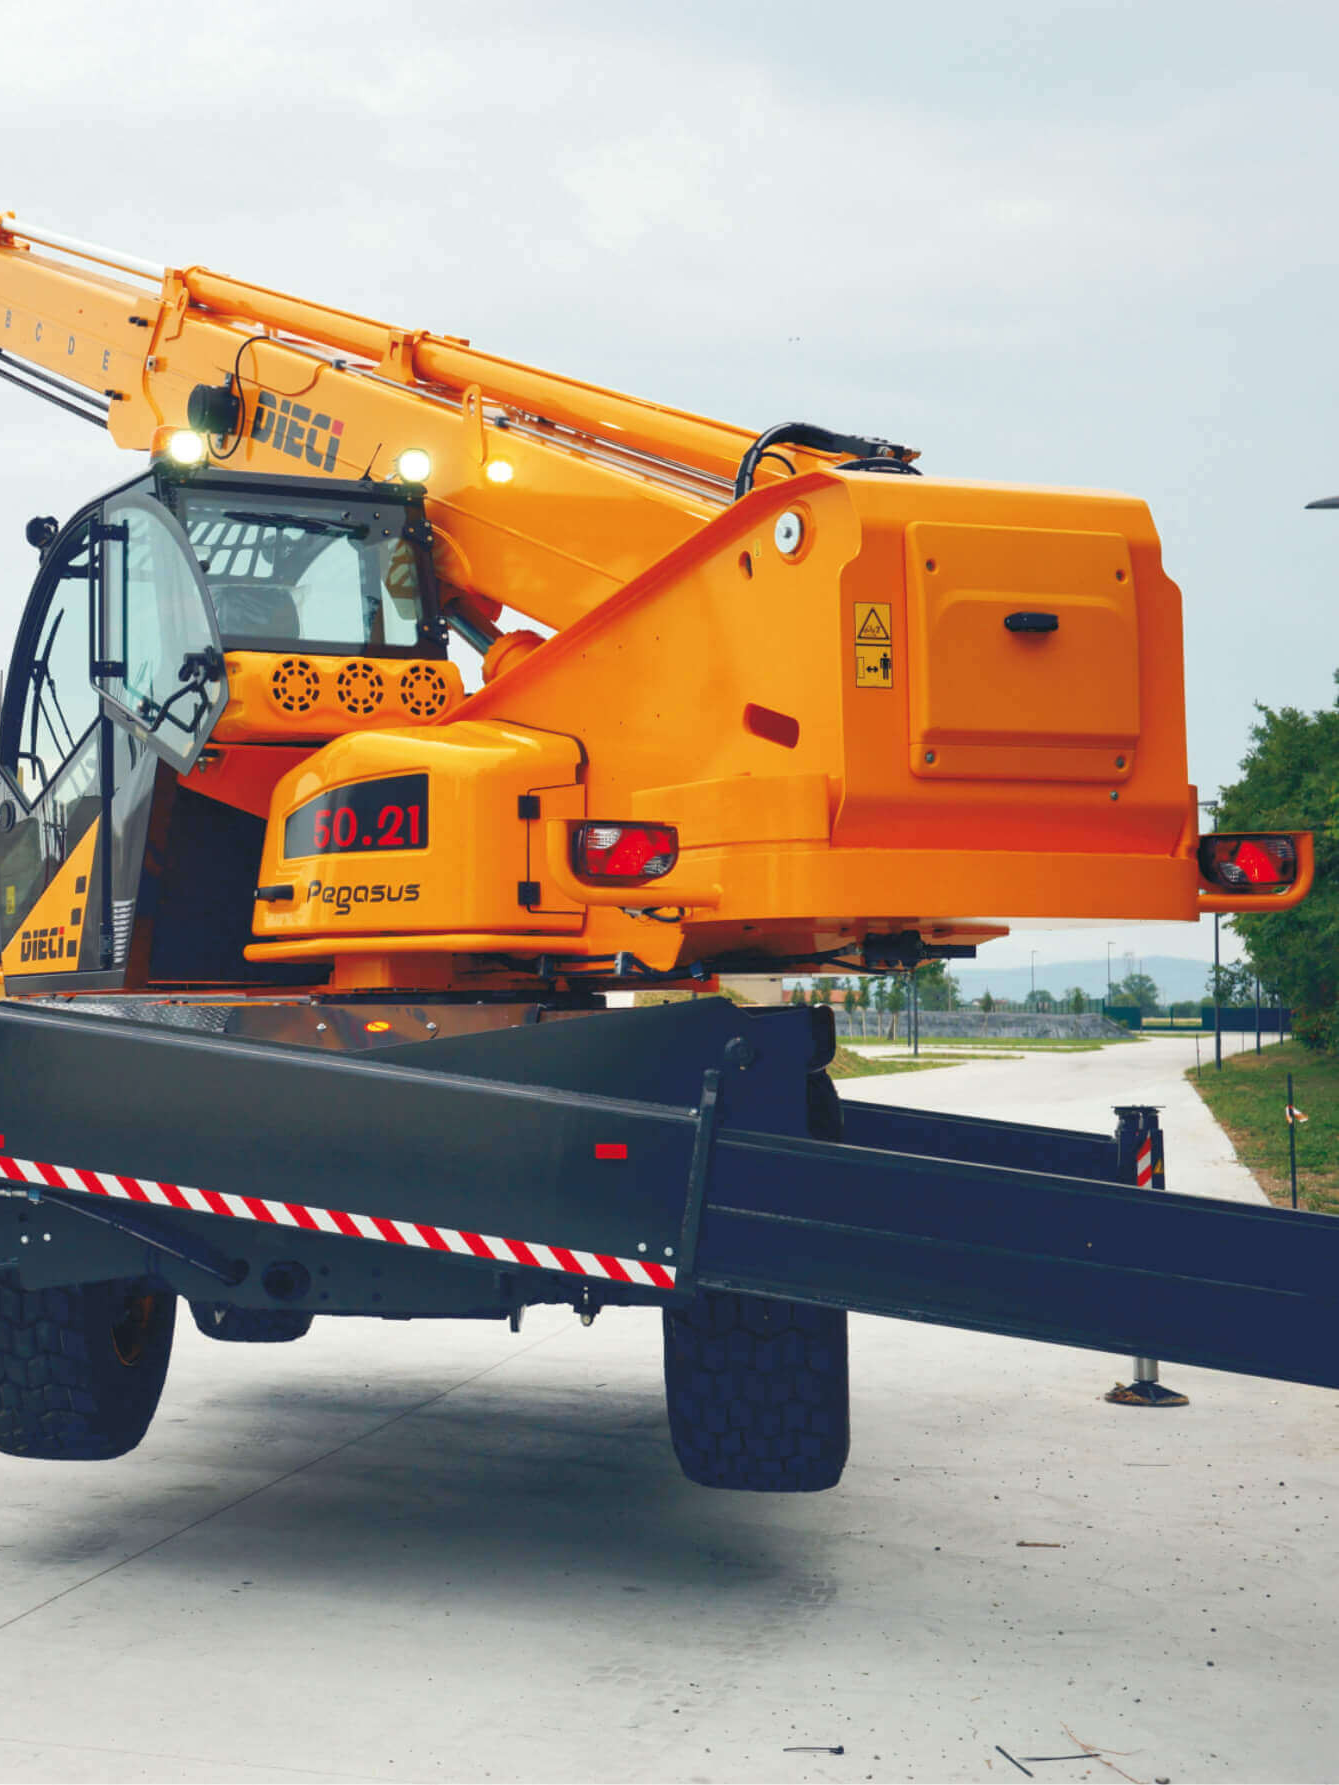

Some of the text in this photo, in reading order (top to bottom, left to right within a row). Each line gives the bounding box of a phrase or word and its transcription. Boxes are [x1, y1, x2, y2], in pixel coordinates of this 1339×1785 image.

[4, 309, 12, 329] B
[35, 321, 43, 342] C
[67, 335, 76, 356] D
[101, 349, 111, 372] E
[250, 389, 345, 474] DIECI
[313, 804, 421, 849] 50.21
[307, 879, 421, 916] Pegasus
[20, 926, 65, 962] DIECI
